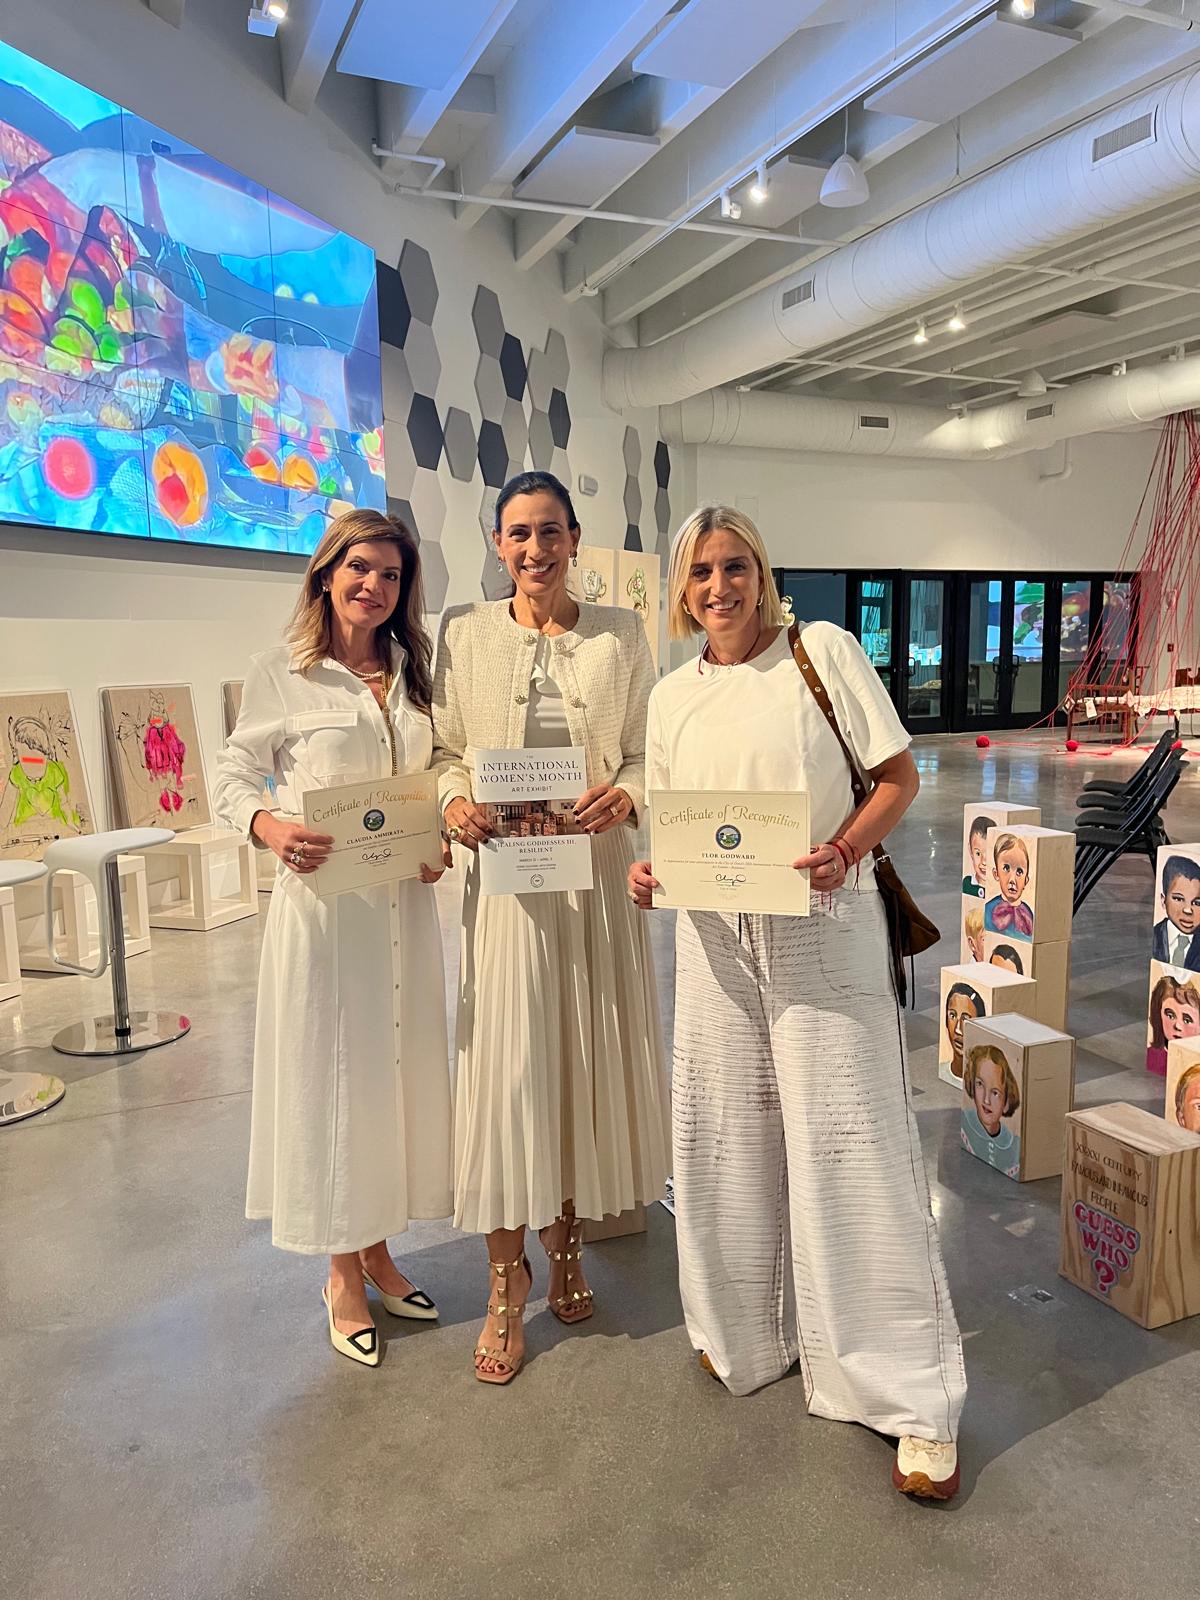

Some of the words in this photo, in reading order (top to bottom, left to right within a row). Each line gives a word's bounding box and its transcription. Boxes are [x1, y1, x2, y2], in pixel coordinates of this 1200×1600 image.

[479, 773, 536, 784] WOMEN'S
[538, 771, 583, 783] MONTH
[482, 760, 579, 772] INTERNATIONAL
[526, 785, 553, 793] EXHIBIT
[312, 798, 361, 823] Certificate
[363, 790, 376, 809] of
[658, 805, 715, 826] Certificate
[717, 803, 731, 823] of
[732, 804, 801, 830] Recognition
[346, 833, 374, 845] CLAUDIA
[373, 829, 405, 841] AMMIRATA
[526, 839, 566, 848] GODDESSES
[519, 846, 554, 855] RESILIENT
[720, 852, 756, 860] GODWARD
[1102, 1155, 1144, 1181] CENTURY
[1071, 1159, 1099, 1184] FAMOUS
[1098, 1174, 1112, 1190] AND
[1112, 1179, 1149, 1208] INFAMOUS
[1090, 1191, 1120, 1215] PEOPLE
[1074, 1202, 1138, 1252] GUESS
[1080, 1227, 1129, 1269] WHO
[1093, 1258, 1116, 1293] ?
